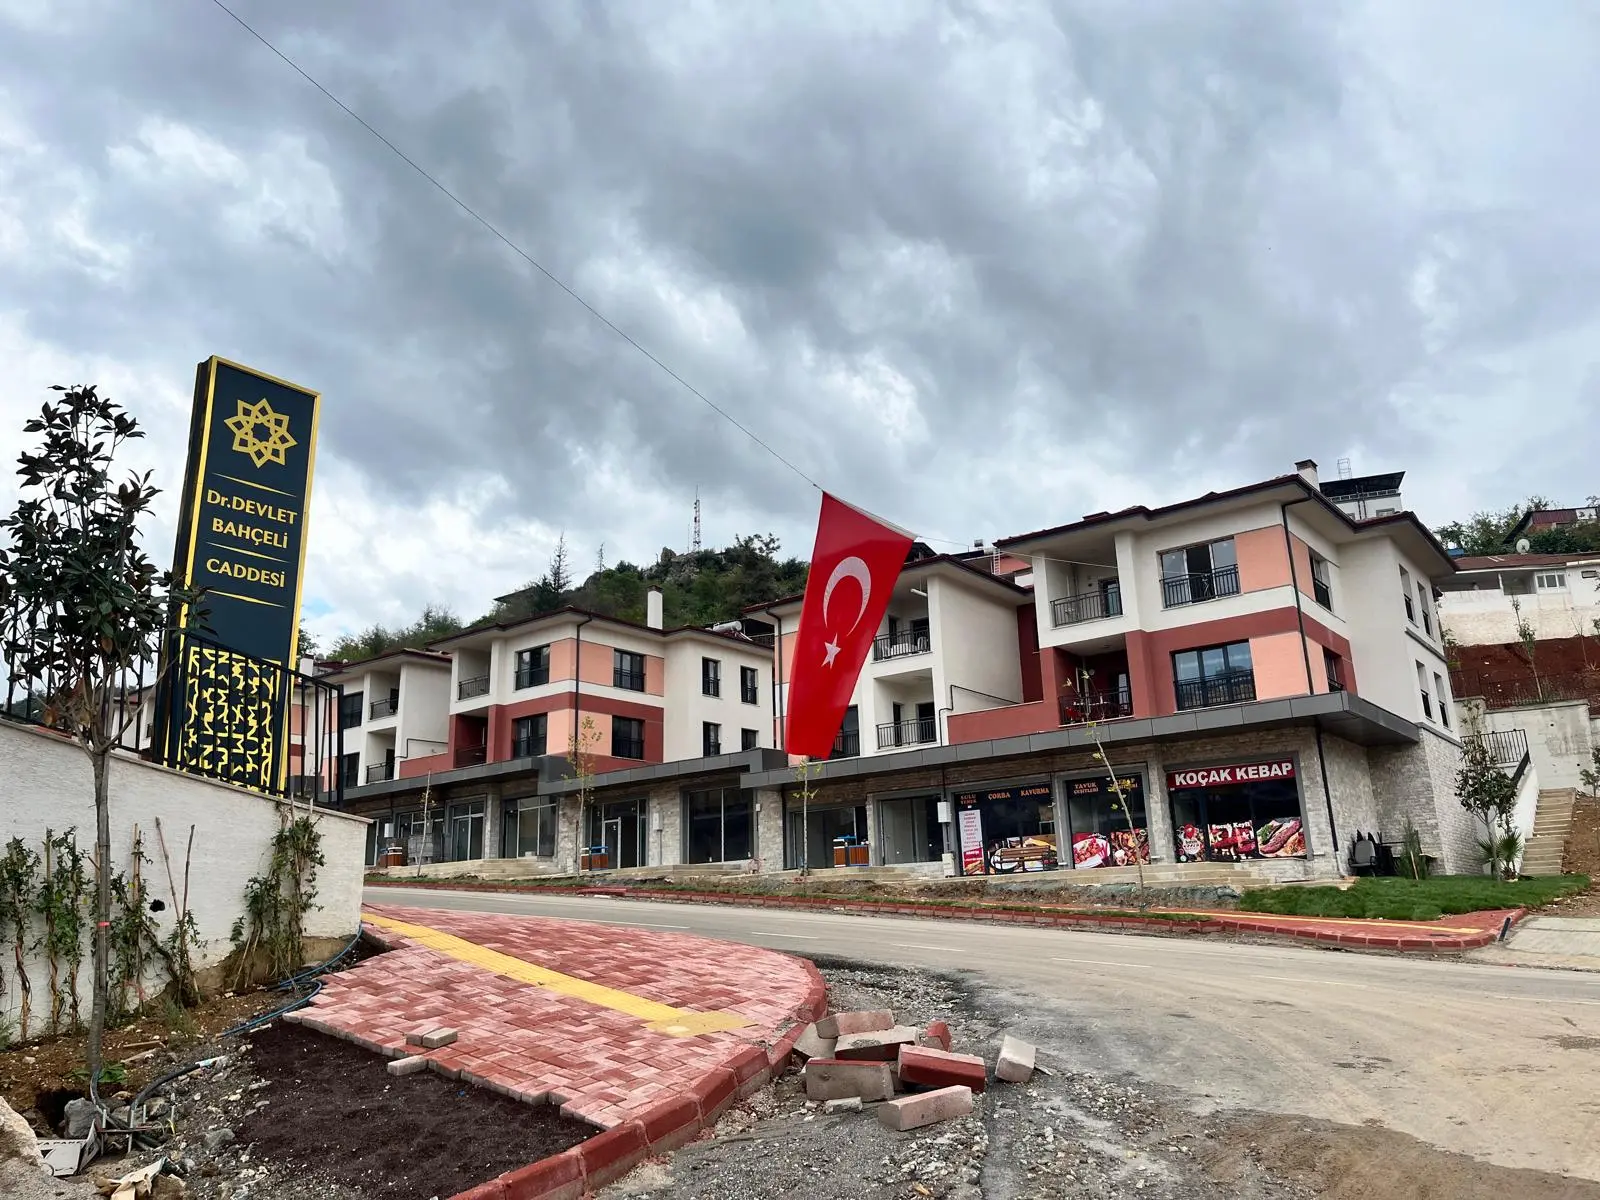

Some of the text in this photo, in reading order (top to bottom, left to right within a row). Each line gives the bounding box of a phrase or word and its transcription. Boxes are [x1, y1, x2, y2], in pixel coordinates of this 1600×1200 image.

[207, 489, 297, 525] Dr.DEVLET
[212, 517, 288, 549] BAHÇELİ
[206, 558, 285, 588] CADDESİ
[1174, 762, 1293, 787] KOÇAK KEBAP
[988, 792, 1011, 800] ÇORBA
[1020, 787, 1050, 797] KAVURMA
